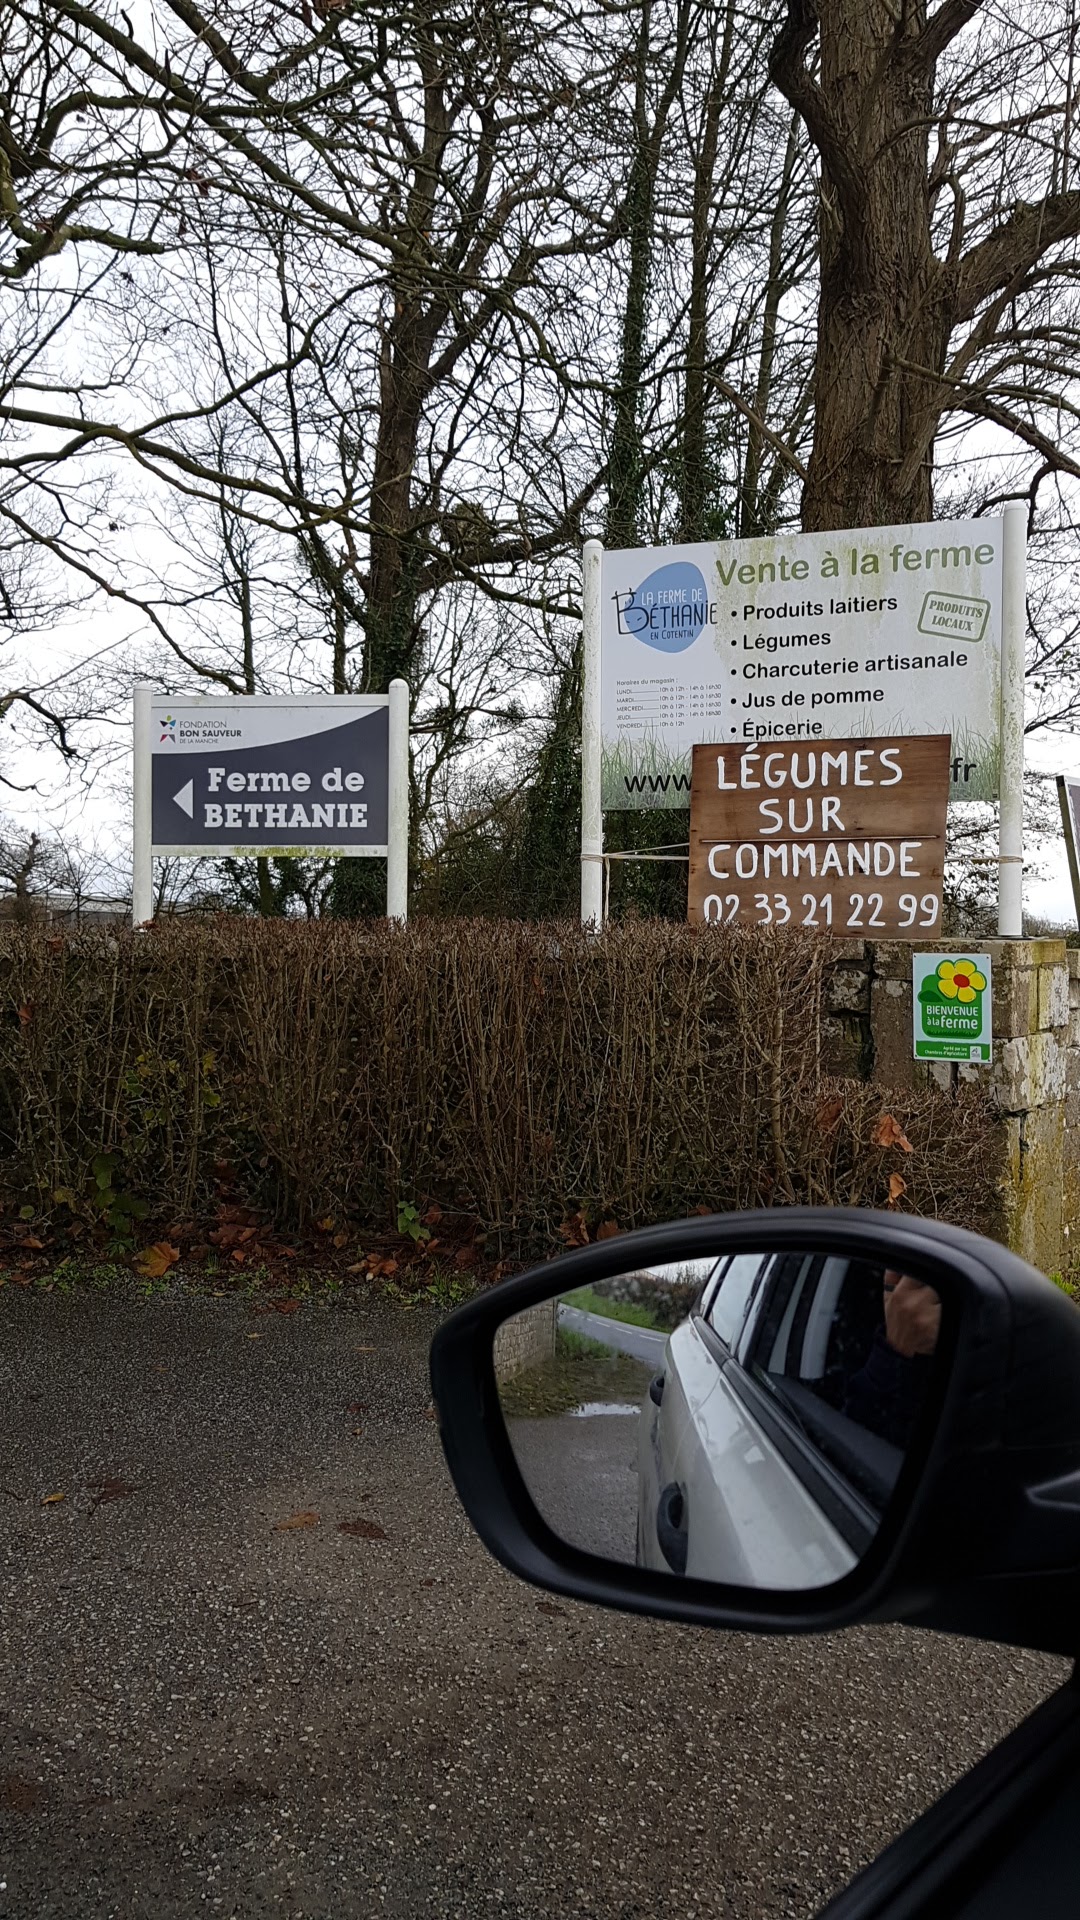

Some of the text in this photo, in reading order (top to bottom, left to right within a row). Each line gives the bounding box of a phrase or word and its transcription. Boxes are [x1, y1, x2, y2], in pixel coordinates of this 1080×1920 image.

[716, 543, 995, 586] Vente à la ferme
[641, 588, 703, 606] LA FERME DE
[743, 597, 898, 621] Produits laitiers
[929, 599, 984, 618] PRODUITS
[931, 615, 974, 632] LOCAUX
[650, 632, 659, 640] EN
[743, 632, 832, 653] Légumes
[742, 650, 968, 679] Charcuterie artisanale
[649, 678, 675, 686] magasin
[742, 688, 885, 708] Jus de pomme
[179, 720, 227, 729] FONDATION
[179, 729, 242, 738] BON SAUVEUR
[742, 718, 823, 740] Épicerie
[717, 743, 903, 790] LÉGUMES
[207, 767, 365, 793] Ferme de
[204, 803, 368, 828] BETHANIE
[758, 796, 846, 835] SUR
[707, 841, 923, 879] COMMANDE
[703, 893, 939, 927] 02 33 21 22 99
[926, 1005, 978, 1016] BIENVENUE
[927, 1015, 978, 1029] à la ferme
